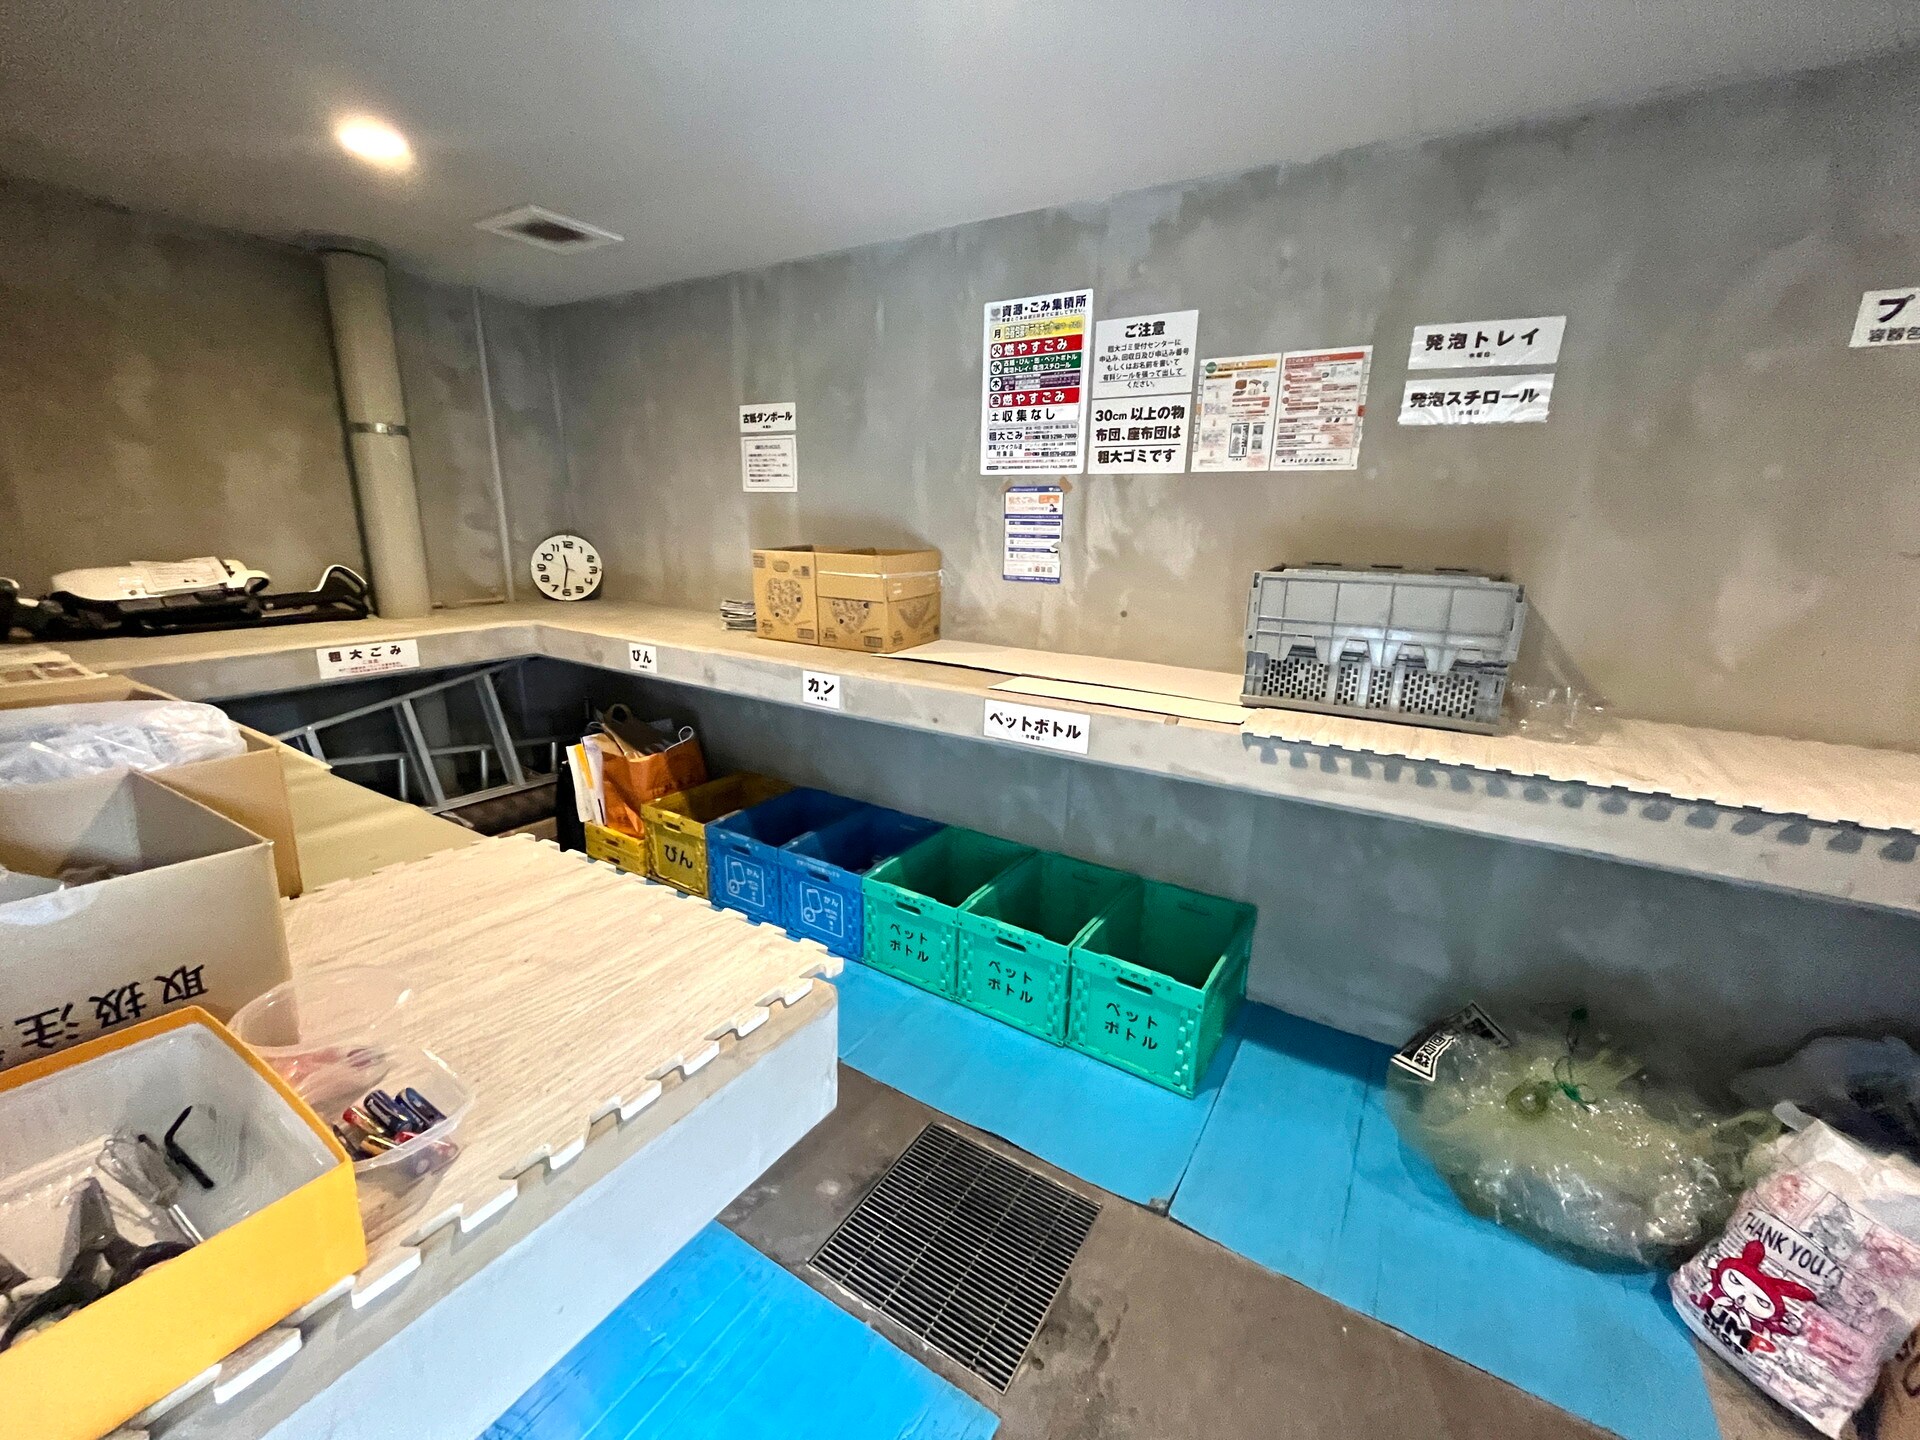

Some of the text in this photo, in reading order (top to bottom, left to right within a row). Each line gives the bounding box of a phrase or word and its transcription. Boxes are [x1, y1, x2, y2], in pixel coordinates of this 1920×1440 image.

[993, 328, 1002, 339] 月
[1125, 321, 1166, 338] ご注意
[1004, 338, 1068, 356] 燃やすごみ
[1425, 328, 1540, 351] 発泡トレイ
[1002, 391, 1065, 406] 燃やすごみ
[1410, 388, 1540, 408] 発泡スチロール
[1002, 408, 1055, 422] 収集なし
[1095, 405, 1185, 421] 30cm 以上の物
[1096, 425, 1181, 441] 布団、座布団は
[1097, 448, 1176, 464] 粗大ゴミです
[551, 543, 560, 552] 11
[561, 540, 574, 549] 12
[578, 545, 583, 554] 1
[541, 552, 554, 562] 10
[586, 554, 595, 563] 2
[537, 563, 547, 572] 9
[588, 566, 598, 575] 3
[540, 574, 550, 583] 8
[584, 578, 593, 586] 4
[551, 584, 560, 593] 7
[562, 588, 572, 597] 6
[575, 585, 585, 594] 5
[632, 649, 652, 664] びん
[808, 677, 835, 695] カン
[989, 711, 1082, 739] ペットボトル
[663, 844, 693, 869] びん
[890, 923, 928, 944] ペット
[890, 939, 929, 963] ボトル
[988, 960, 1033, 985] ペット
[988, 977, 1034, 1003] ボトル
[0, 964, 209, 1063] 取扱注
[1106, 1002, 1158, 1029] ペット
[1104, 1021, 1158, 1050] ボトル
[1740, 1211, 1790, 1255] THANK
